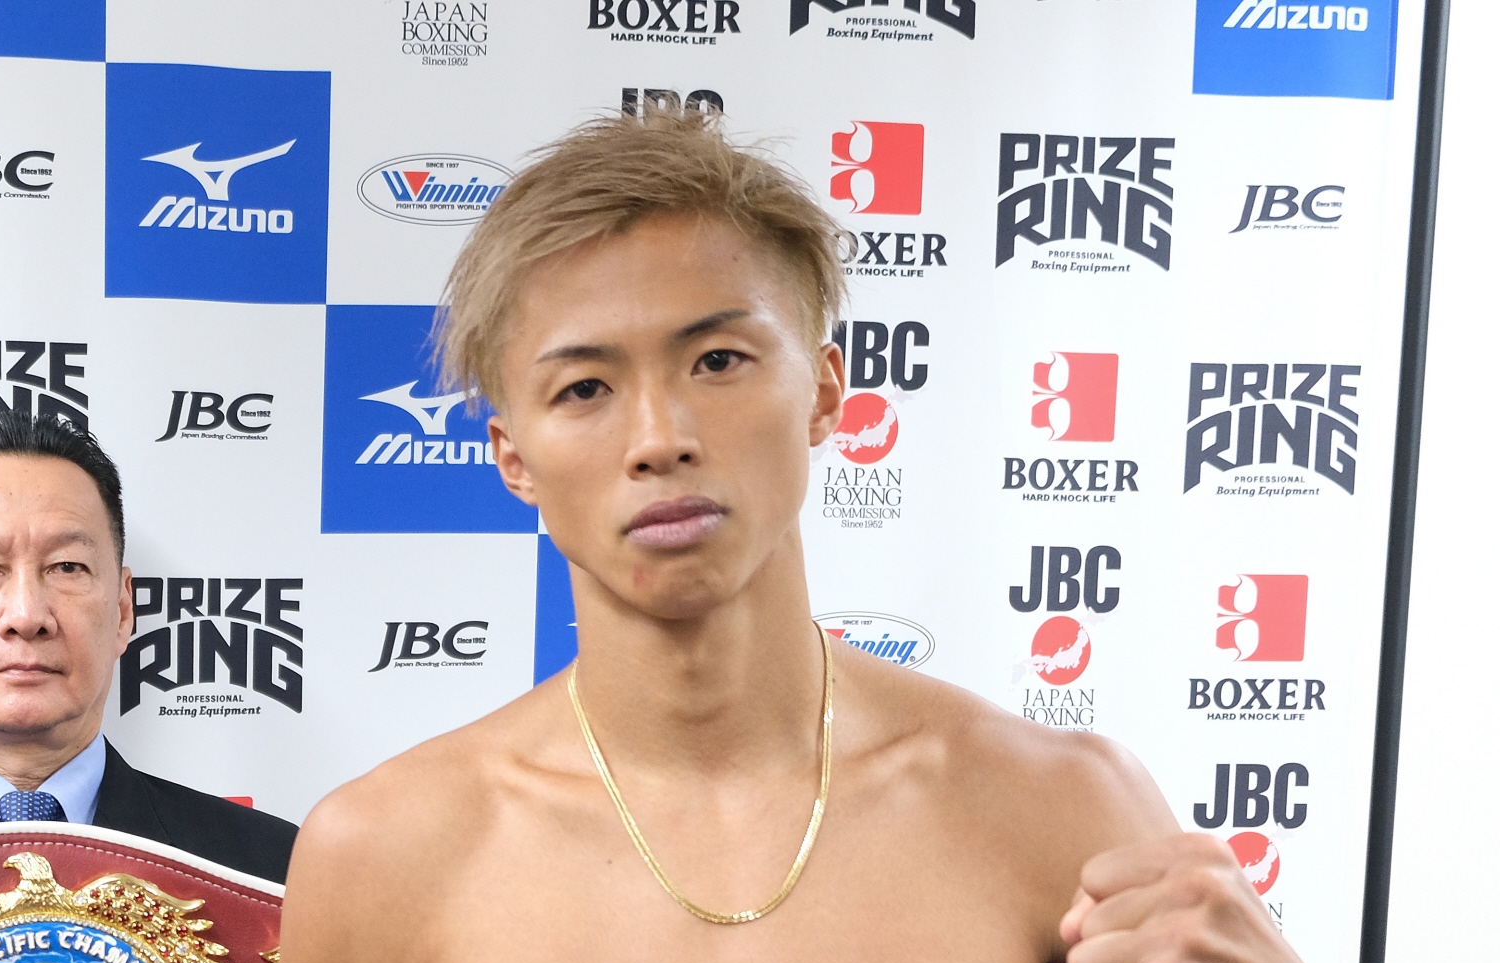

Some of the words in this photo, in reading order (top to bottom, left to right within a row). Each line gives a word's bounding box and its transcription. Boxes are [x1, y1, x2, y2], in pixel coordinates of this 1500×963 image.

[402, 1, 488, 22] JAPAN
[587, 0, 741, 34] BOXER
[402, 22, 488, 43] BOXING
[845, 17, 918, 28] PROFESSIONAL
[610, 33, 644, 43] HARD
[646, 34, 689, 44] KNOCK
[691, 36, 717, 45] LIFE
[826, 27, 869, 40] Boxing
[871, 28, 934, 42] Equipment
[401, 43, 487, 57] COMMISSION
[998, 133, 1176, 201] PRIZE
[1228, 185, 1345, 234] JBC
[995, 177, 1173, 272] RING
[834, 230, 948, 267] OXER
[1048, 250, 1115, 260] PROFESSIONAL
[855, 267, 898, 277] KNOCK
[900, 268, 925, 278] LIFE
[1031, 260, 1068, 273] Boxing
[1069, 261, 1131, 274] Equipment
[832, 320, 930, 392] BC
[1187, 362, 1361, 427] PRIZE
[155, 390, 274, 443] JBC
[1183, 403, 1358, 496] RING
[823, 466, 902, 487] JAPAN
[1002, 457, 1139, 492] BOXER
[1234, 475, 1305, 484] PROFESSIONAL
[823, 486, 902, 506] BOXING
[1022, 493, 1051, 502] HARD
[1052, 494, 1090, 503] KNOCK
[1093, 495, 1116, 503] LIFE
[1215, 486, 1256, 498] Boxing
[1257, 486, 1320, 498] Equipment
[822, 507, 901, 520] COMMISSION
[1009, 545, 1122, 614] JBC
[131, 577, 304, 643] PRIZE
[367, 620, 489, 673] JBC
[120, 619, 304, 717] RING
[176, 694, 244, 704] PROFESSIONAL
[1023, 688, 1095, 707] JAPAN
[1187, 678, 1326, 711] BOXER
[158, 705, 198, 718] Boxing
[199, 705, 261, 718] Equipment
[1022, 707, 1095, 726] BOXING
[1206, 713, 1237, 721] HARD
[1239, 713, 1280, 721] KNOCK
[1283, 713, 1305, 721] LIFE
[1193, 762, 1310, 829] JBC
